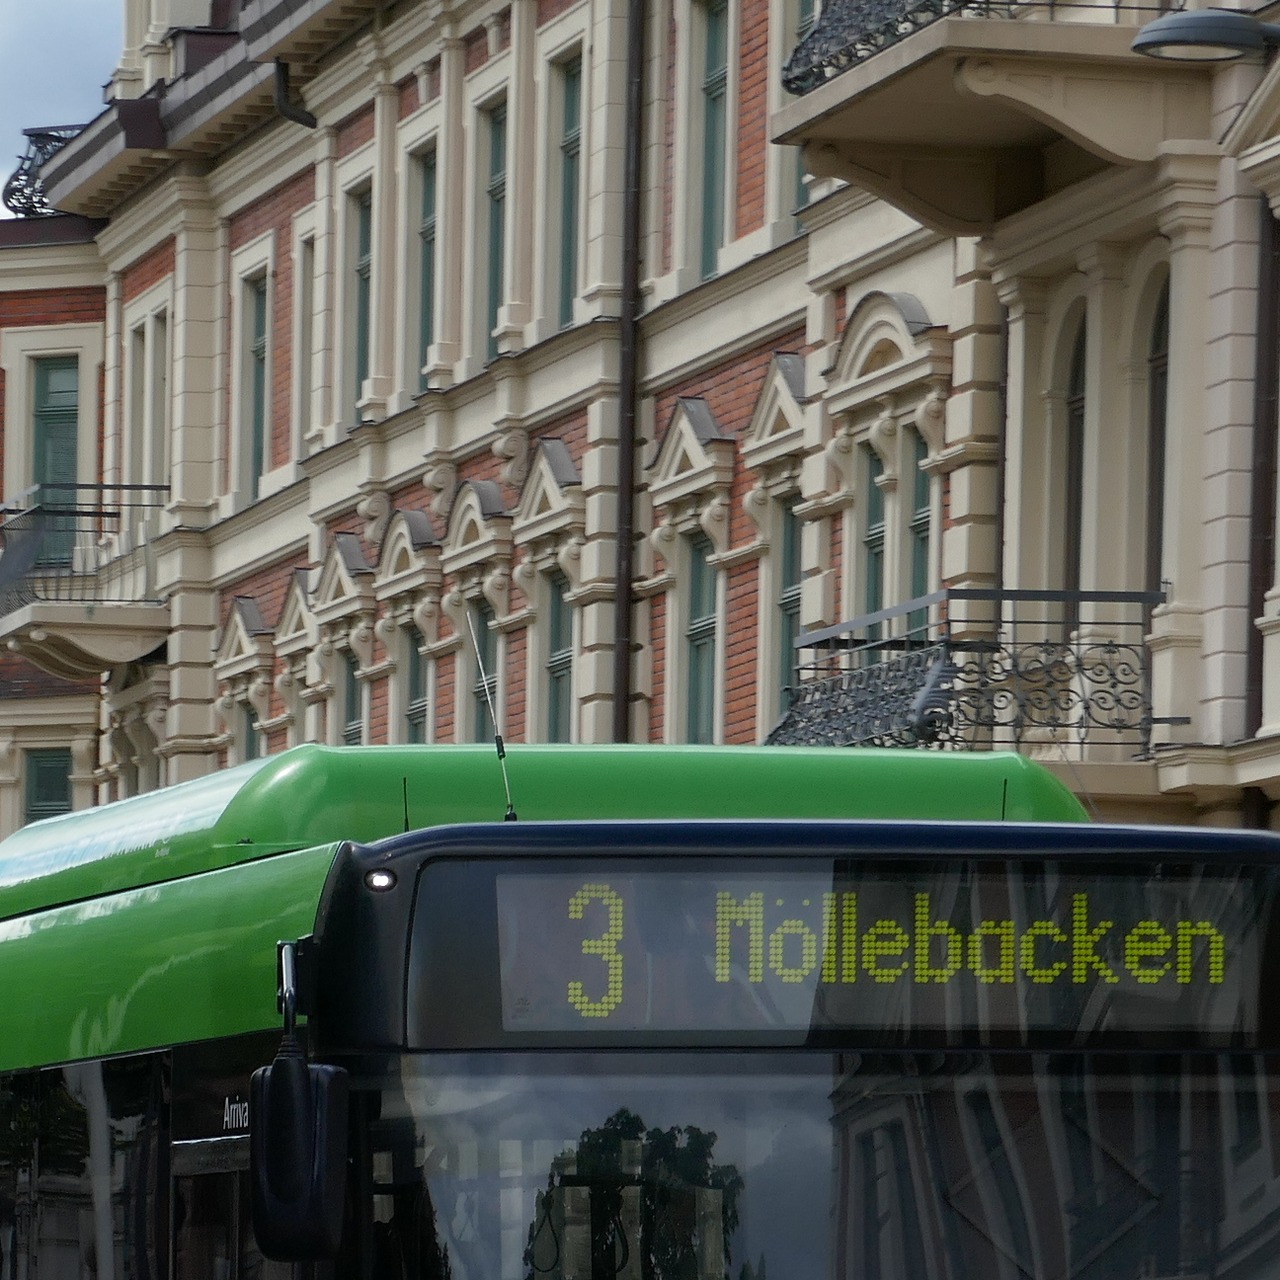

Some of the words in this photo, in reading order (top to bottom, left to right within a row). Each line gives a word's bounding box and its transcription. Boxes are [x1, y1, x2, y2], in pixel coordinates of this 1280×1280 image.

[568, 884, 622, 1018] 3
[716, 892, 1223, 984] Möllebacken
[223, 1095, 249, 1130] Arriva
